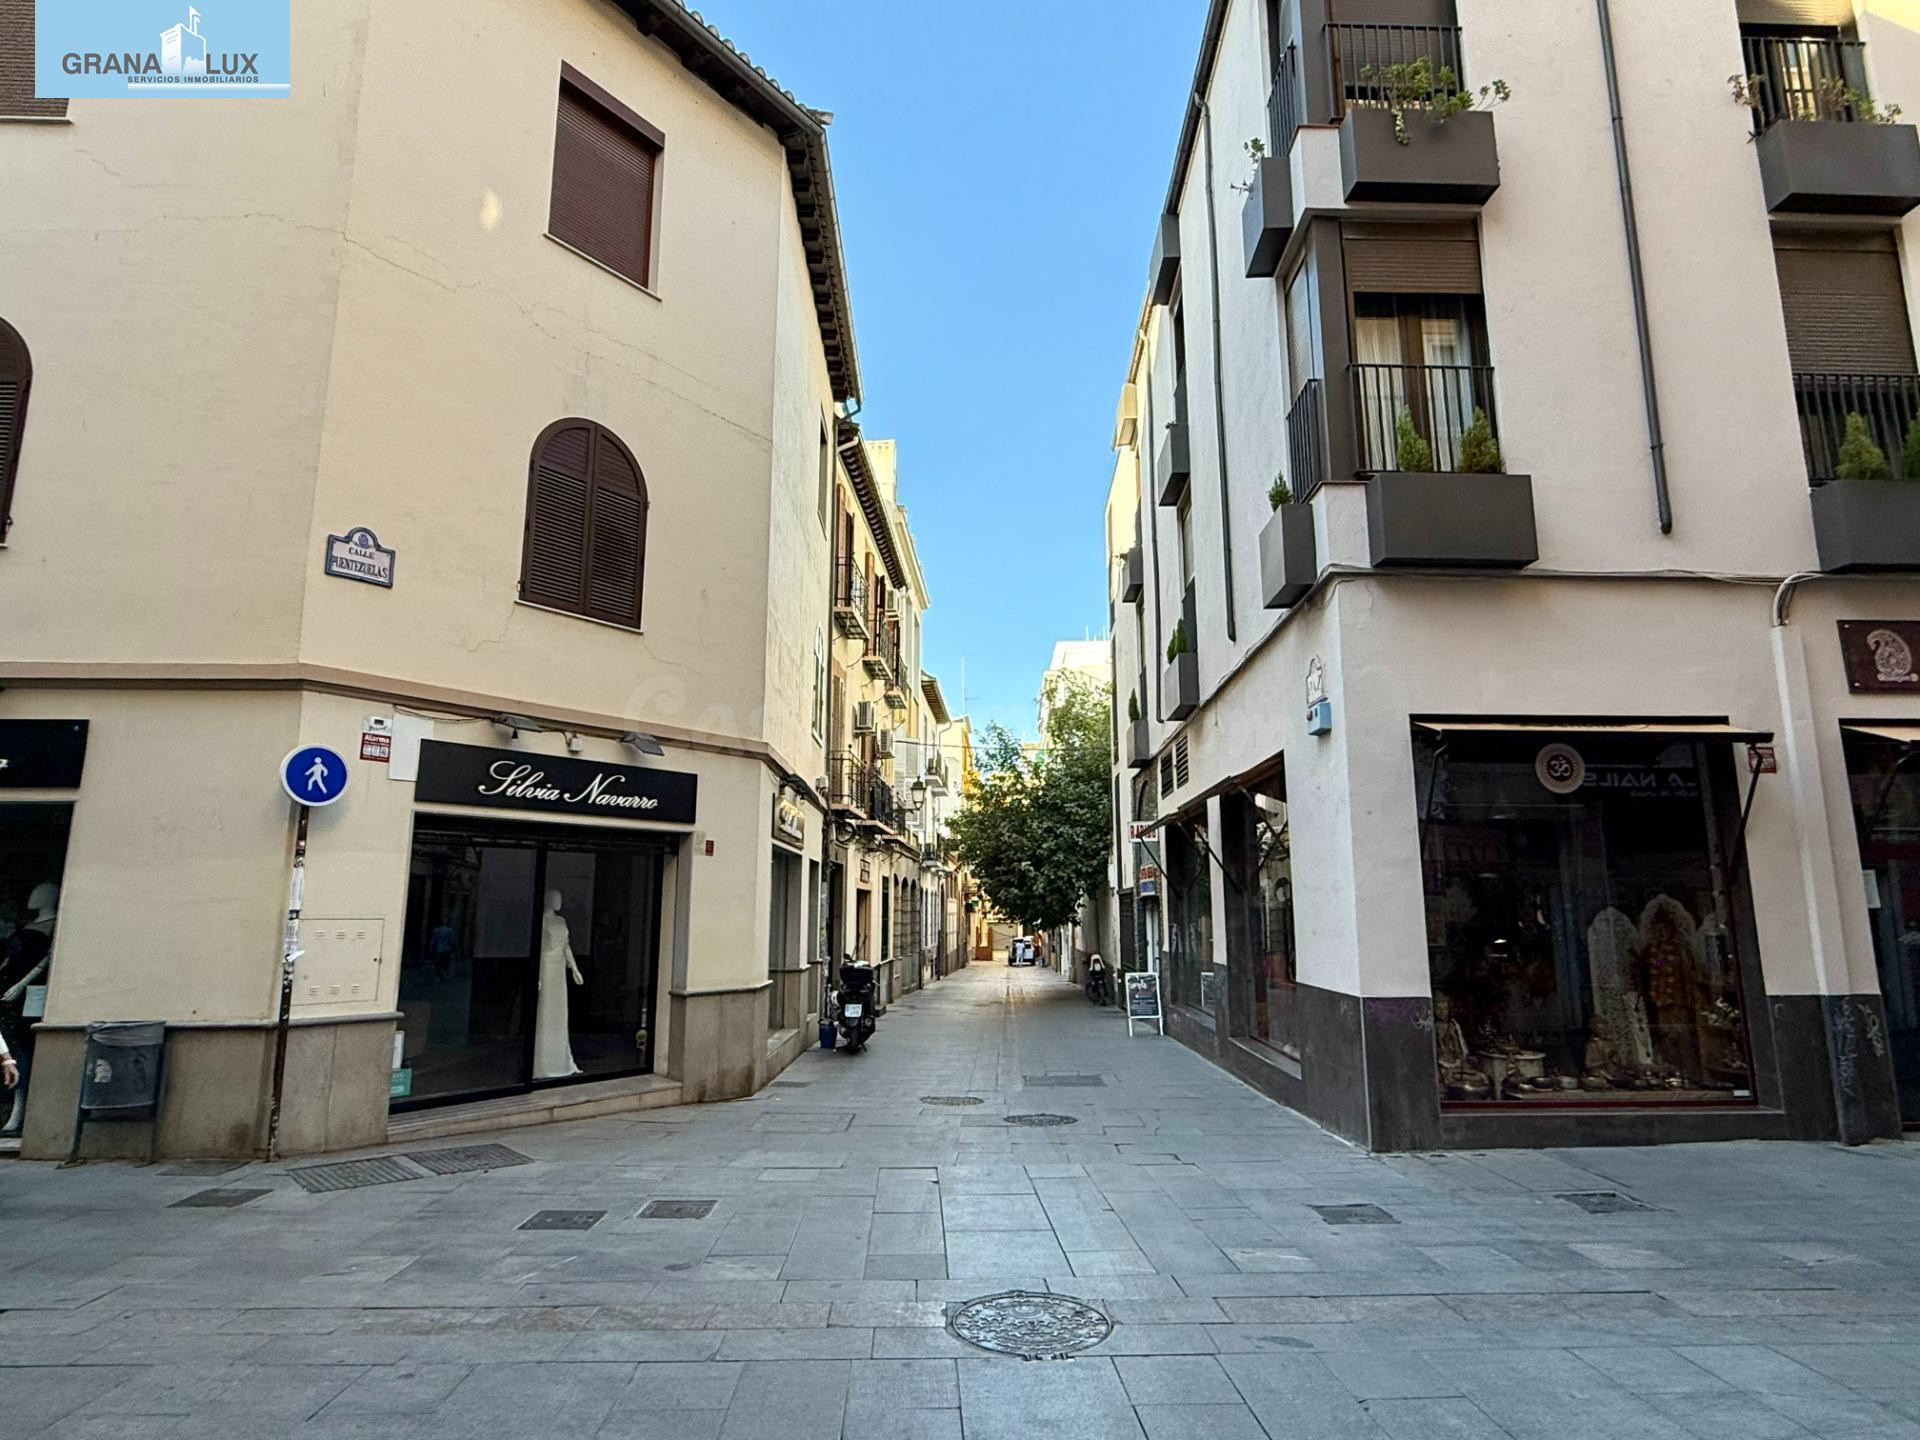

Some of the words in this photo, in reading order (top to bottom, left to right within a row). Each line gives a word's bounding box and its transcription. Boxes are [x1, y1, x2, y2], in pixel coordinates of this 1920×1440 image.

[348, 546, 375, 559] CALLE
[478, 760, 560, 801] Silvia
[563, 773, 658, 809] Navarro
